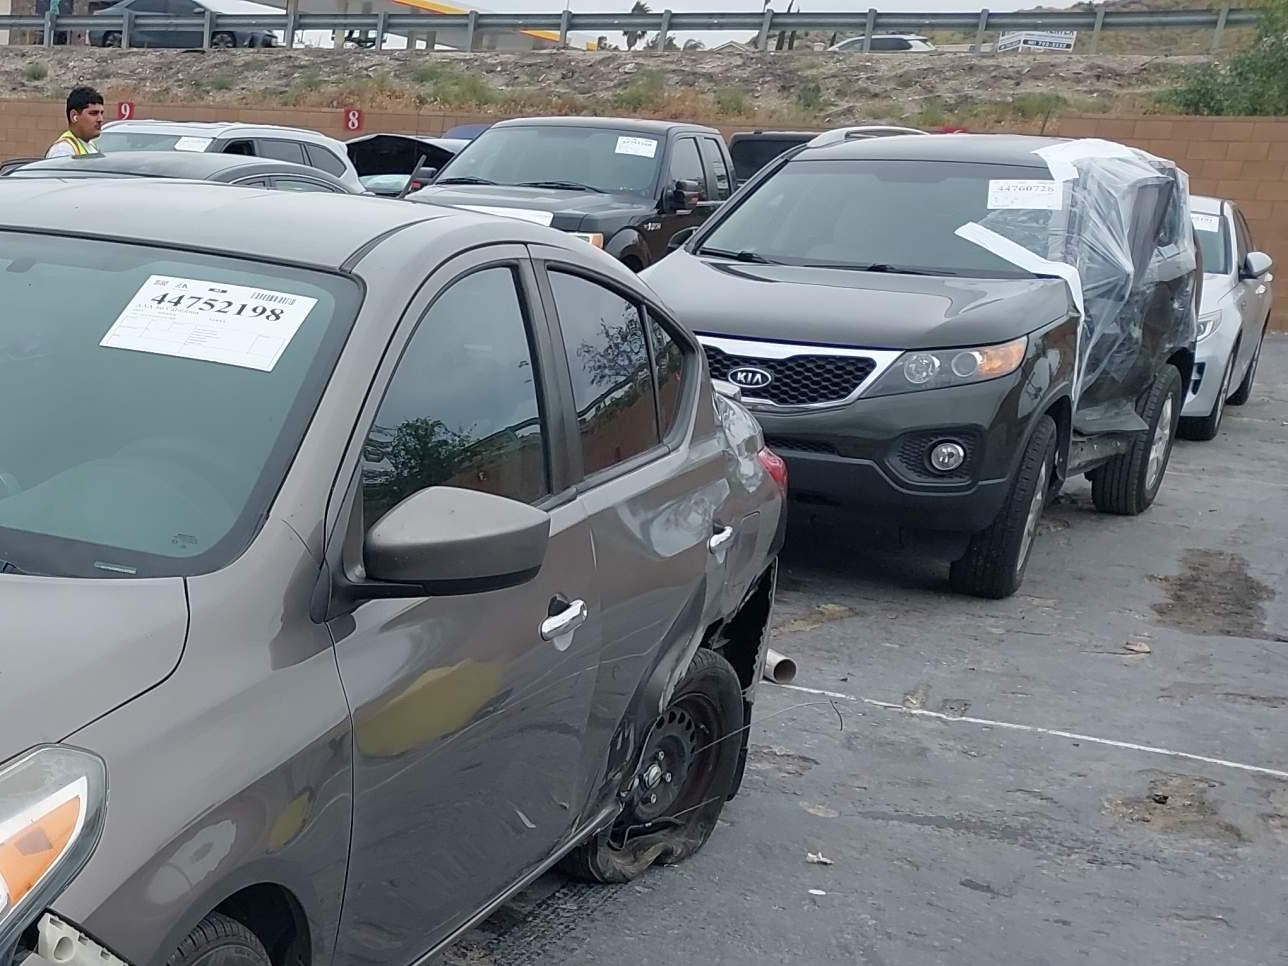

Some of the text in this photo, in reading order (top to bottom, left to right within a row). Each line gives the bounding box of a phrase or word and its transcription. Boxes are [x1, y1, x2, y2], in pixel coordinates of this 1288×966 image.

[121, 104, 130, 120] 9
[348, 110, 358, 129] 8
[151, 292, 284, 321] 44752198
[737, 372, 762, 384] KIA
